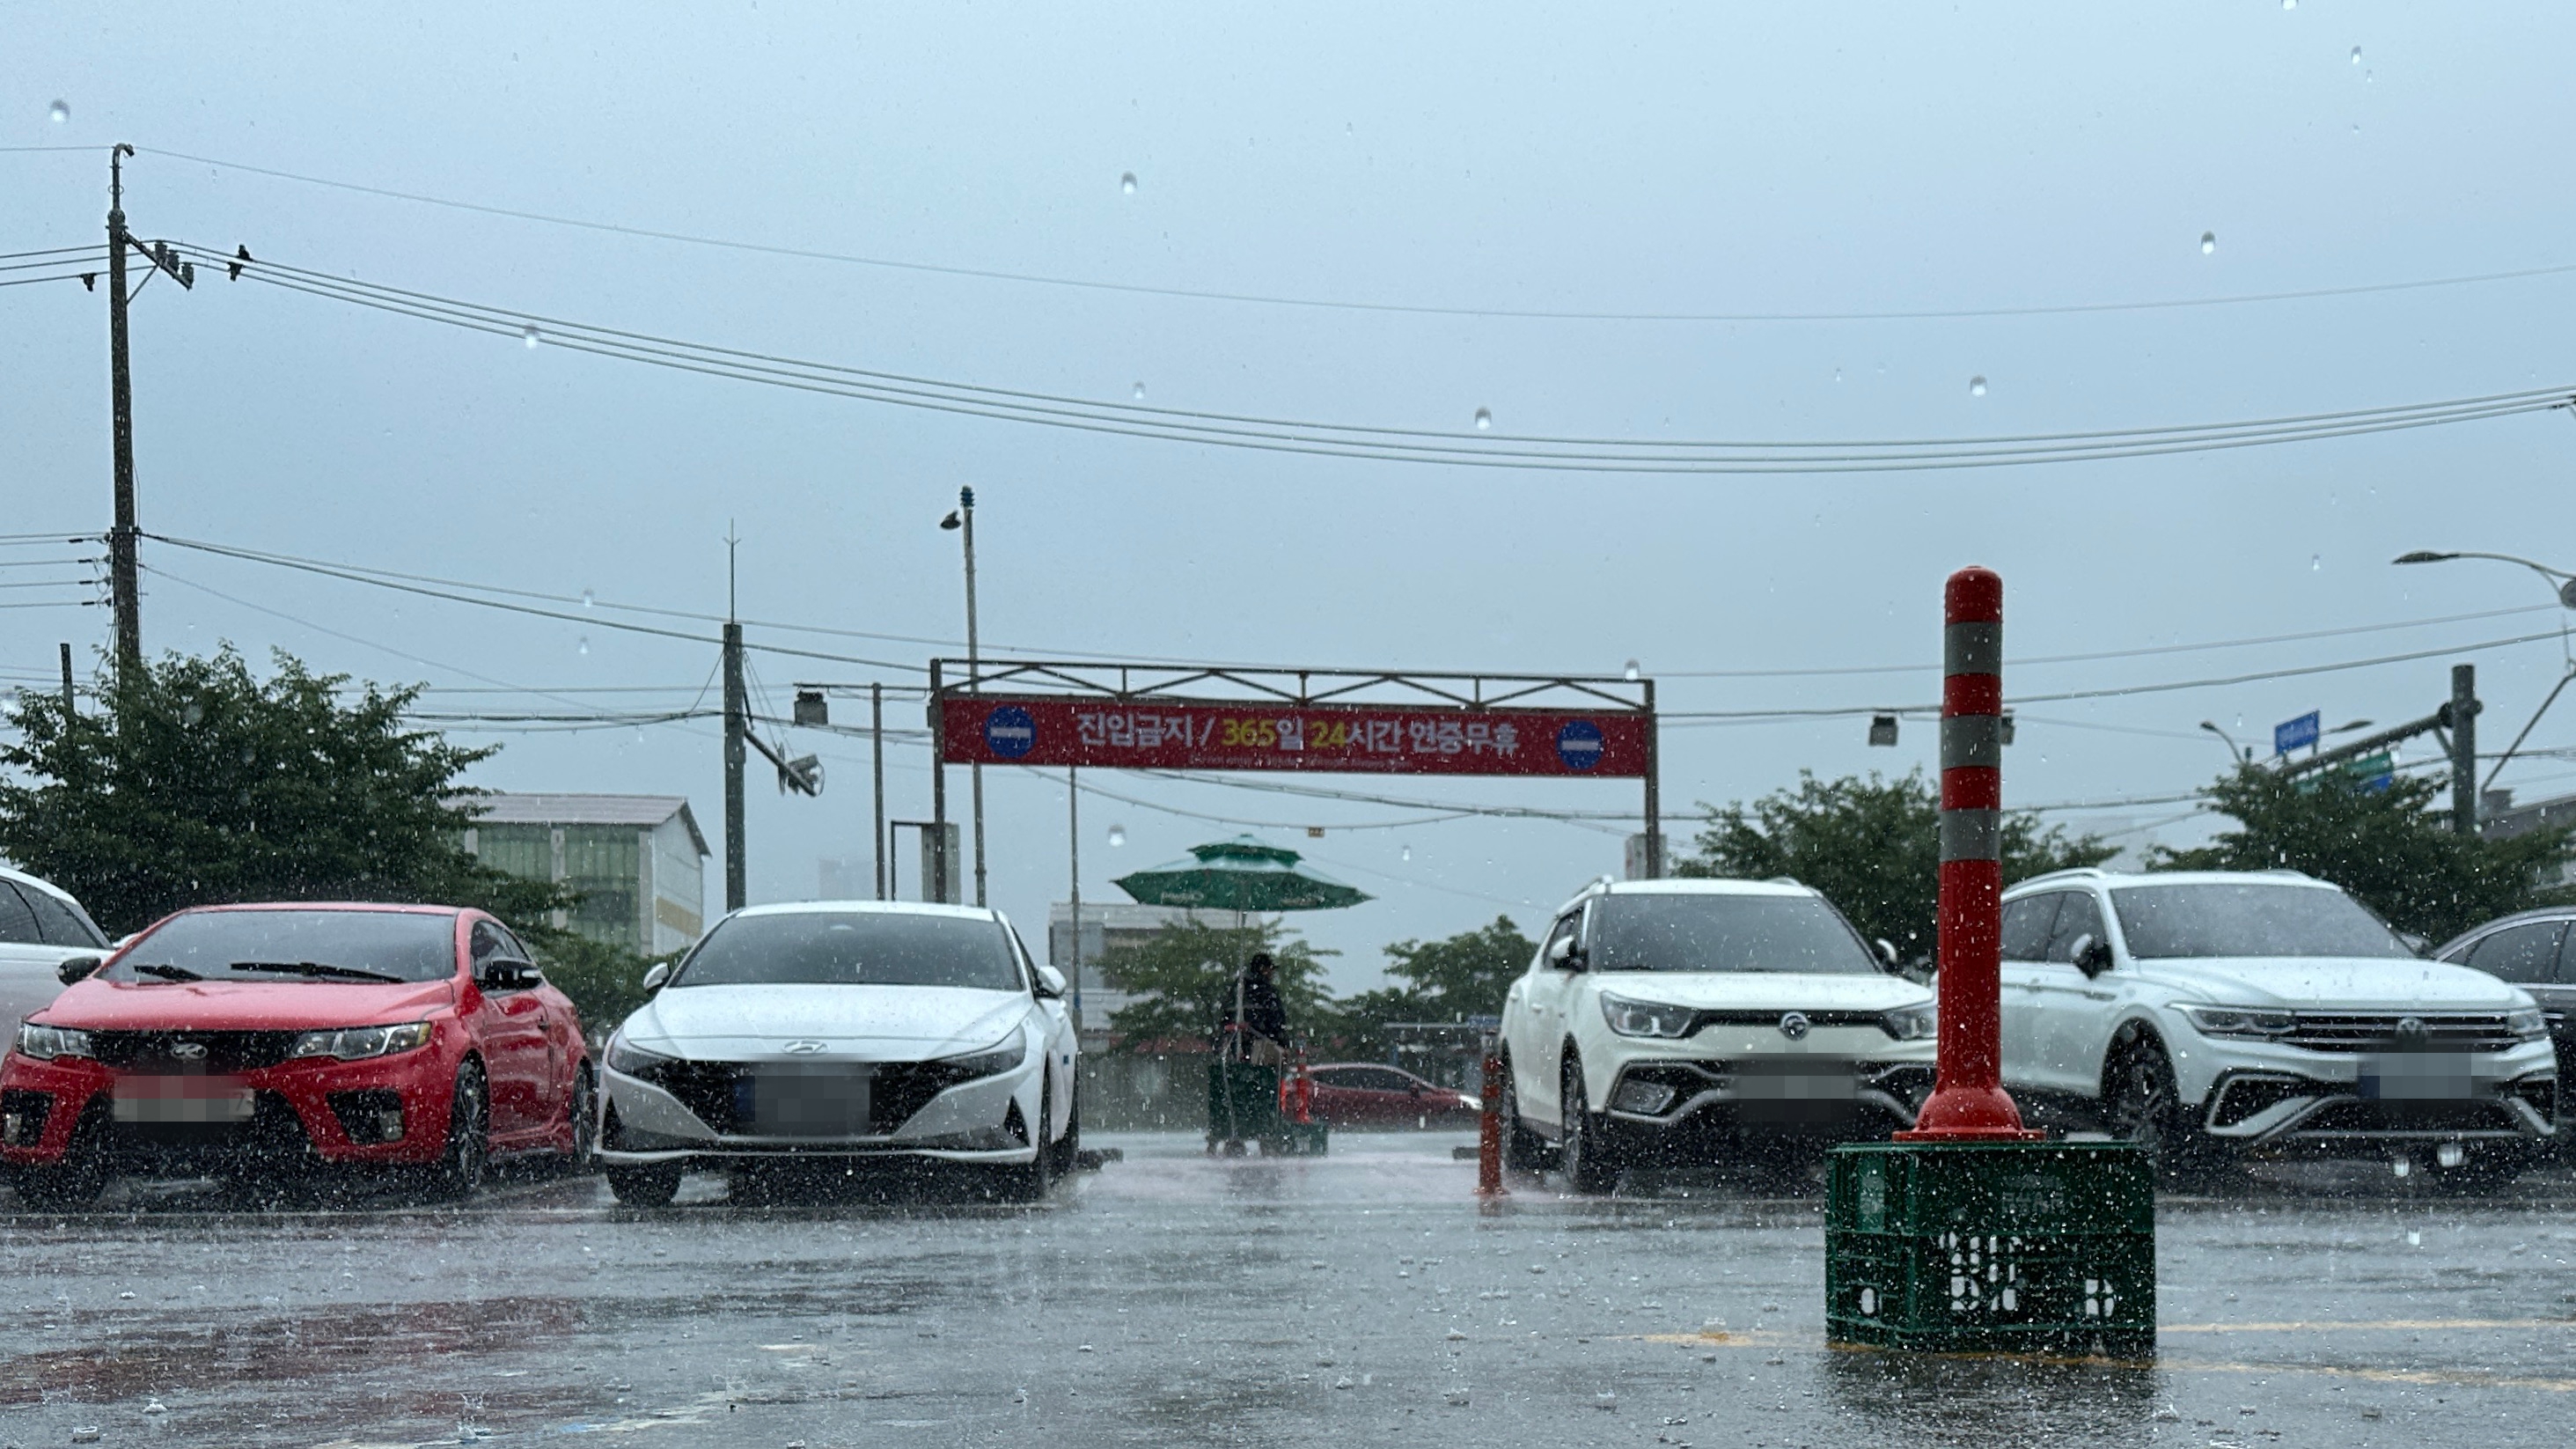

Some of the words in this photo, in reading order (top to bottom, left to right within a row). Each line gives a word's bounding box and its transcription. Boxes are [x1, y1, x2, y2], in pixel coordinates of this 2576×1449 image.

[1077, 713, 1193, 747] 진입금지
[1221, 717, 1304, 751] 365일
[1310, 719, 1405, 753] 24시간
[1410, 720, 1520, 756] 연중무휴
